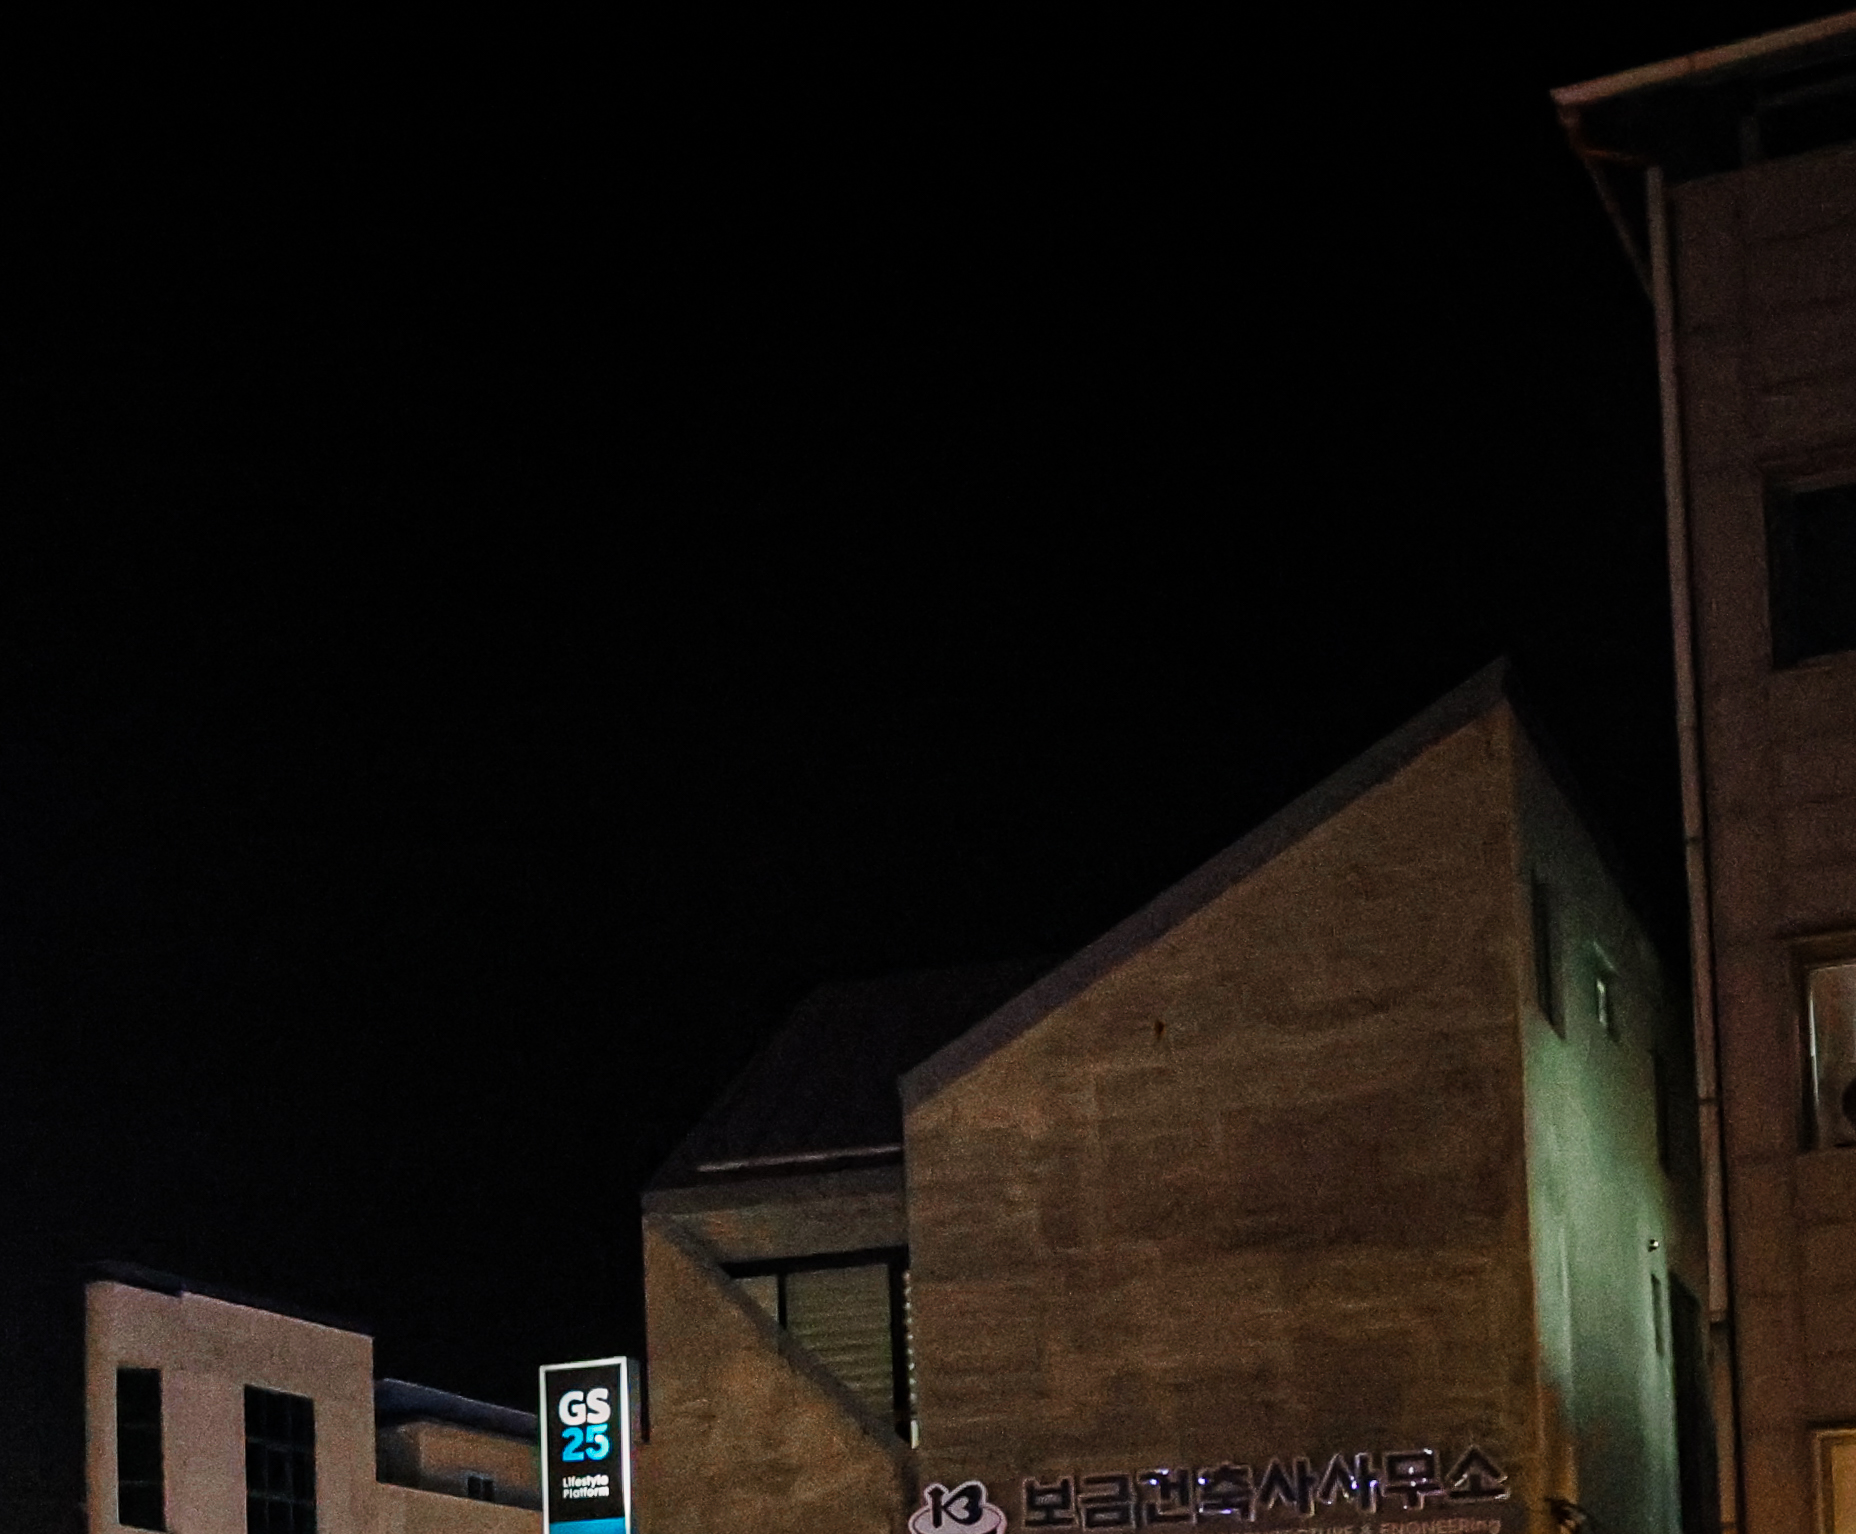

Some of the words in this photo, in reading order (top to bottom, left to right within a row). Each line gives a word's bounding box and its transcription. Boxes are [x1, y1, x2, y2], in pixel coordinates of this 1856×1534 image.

[558, 1388, 611, 1426] GS
[561, 1424, 610, 1462] 25
[562, 1474, 609, 1489] Lifestyle
[562, 1486, 610, 1499] Platform
[1022, 1444, 1511, 1531] 보금건축사사무소
